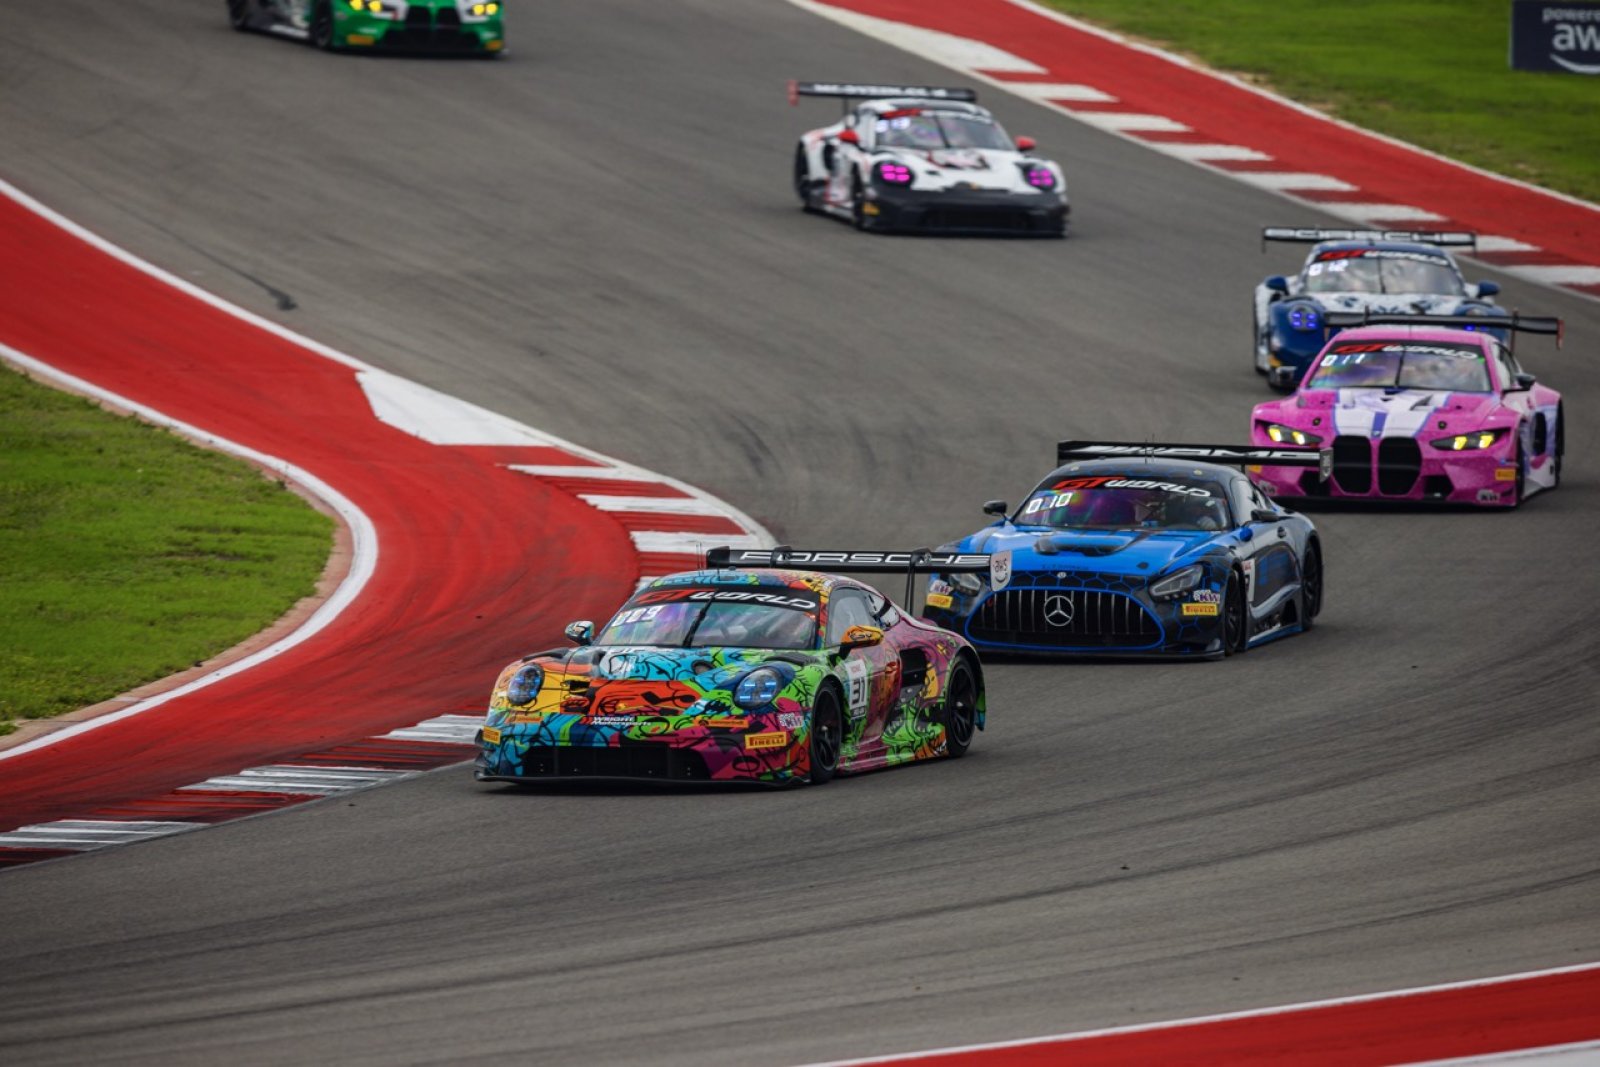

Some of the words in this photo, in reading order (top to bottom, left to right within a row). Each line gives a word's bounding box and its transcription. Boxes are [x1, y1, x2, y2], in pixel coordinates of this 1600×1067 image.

[1052, 476, 1127, 490] GT
[1104, 479, 1211, 497] WORLD
[740, 551, 991, 565] PORSCHE
[637, 588, 718, 603] GT
[689, 591, 816, 608] WORLD
[851, 676, 866, 705] 31
[749, 735, 785, 747] PIRELLI
